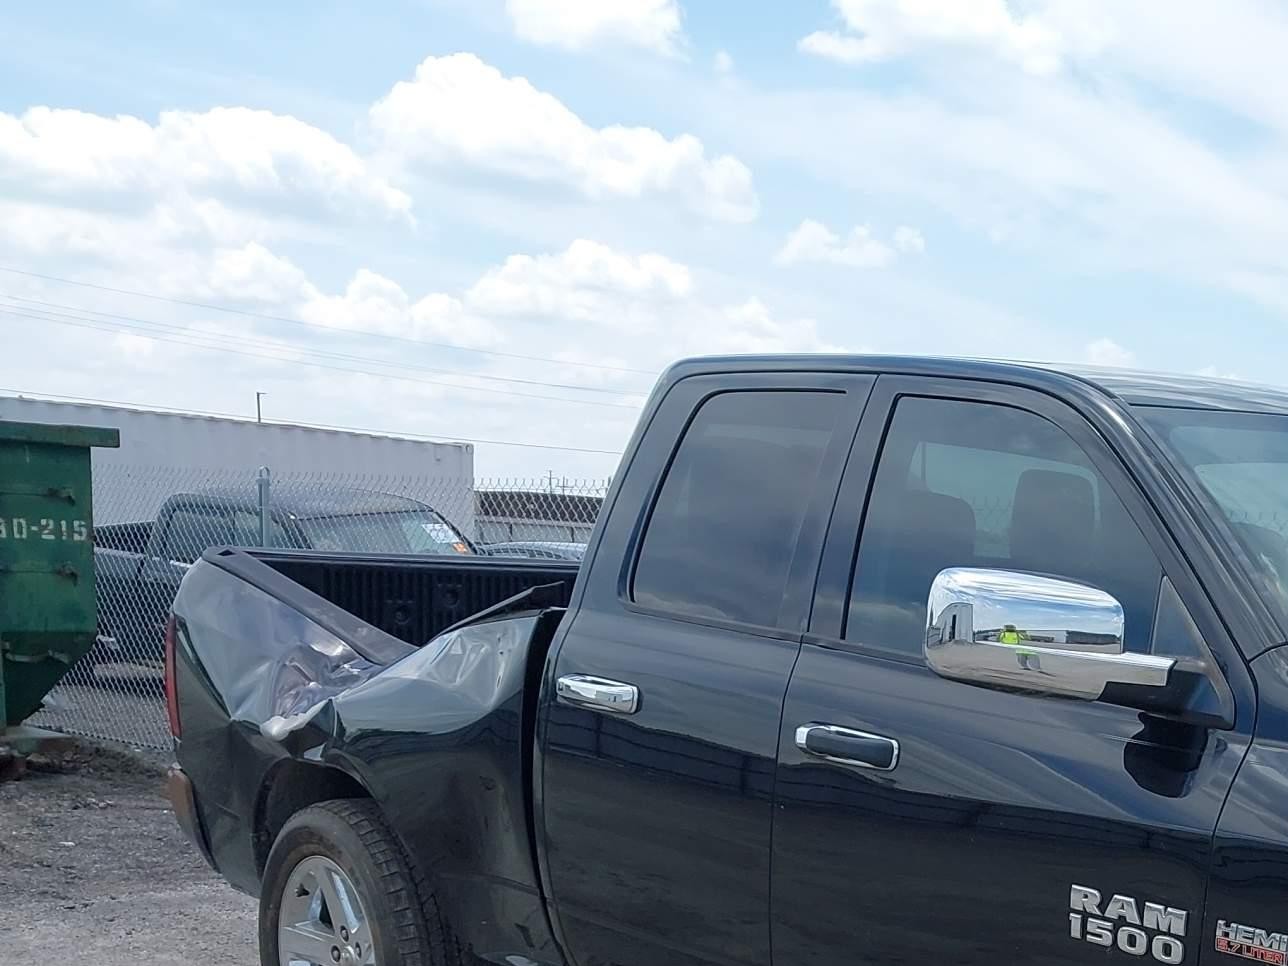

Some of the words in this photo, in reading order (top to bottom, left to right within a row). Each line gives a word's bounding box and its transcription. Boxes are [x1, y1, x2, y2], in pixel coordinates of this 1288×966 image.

[1070, 884, 1188, 937] RAM
[1069, 912, 1184, 965] 1500
[1217, 938, 1240, 953] 5.7
[1242, 944, 1283, 964] LITER
